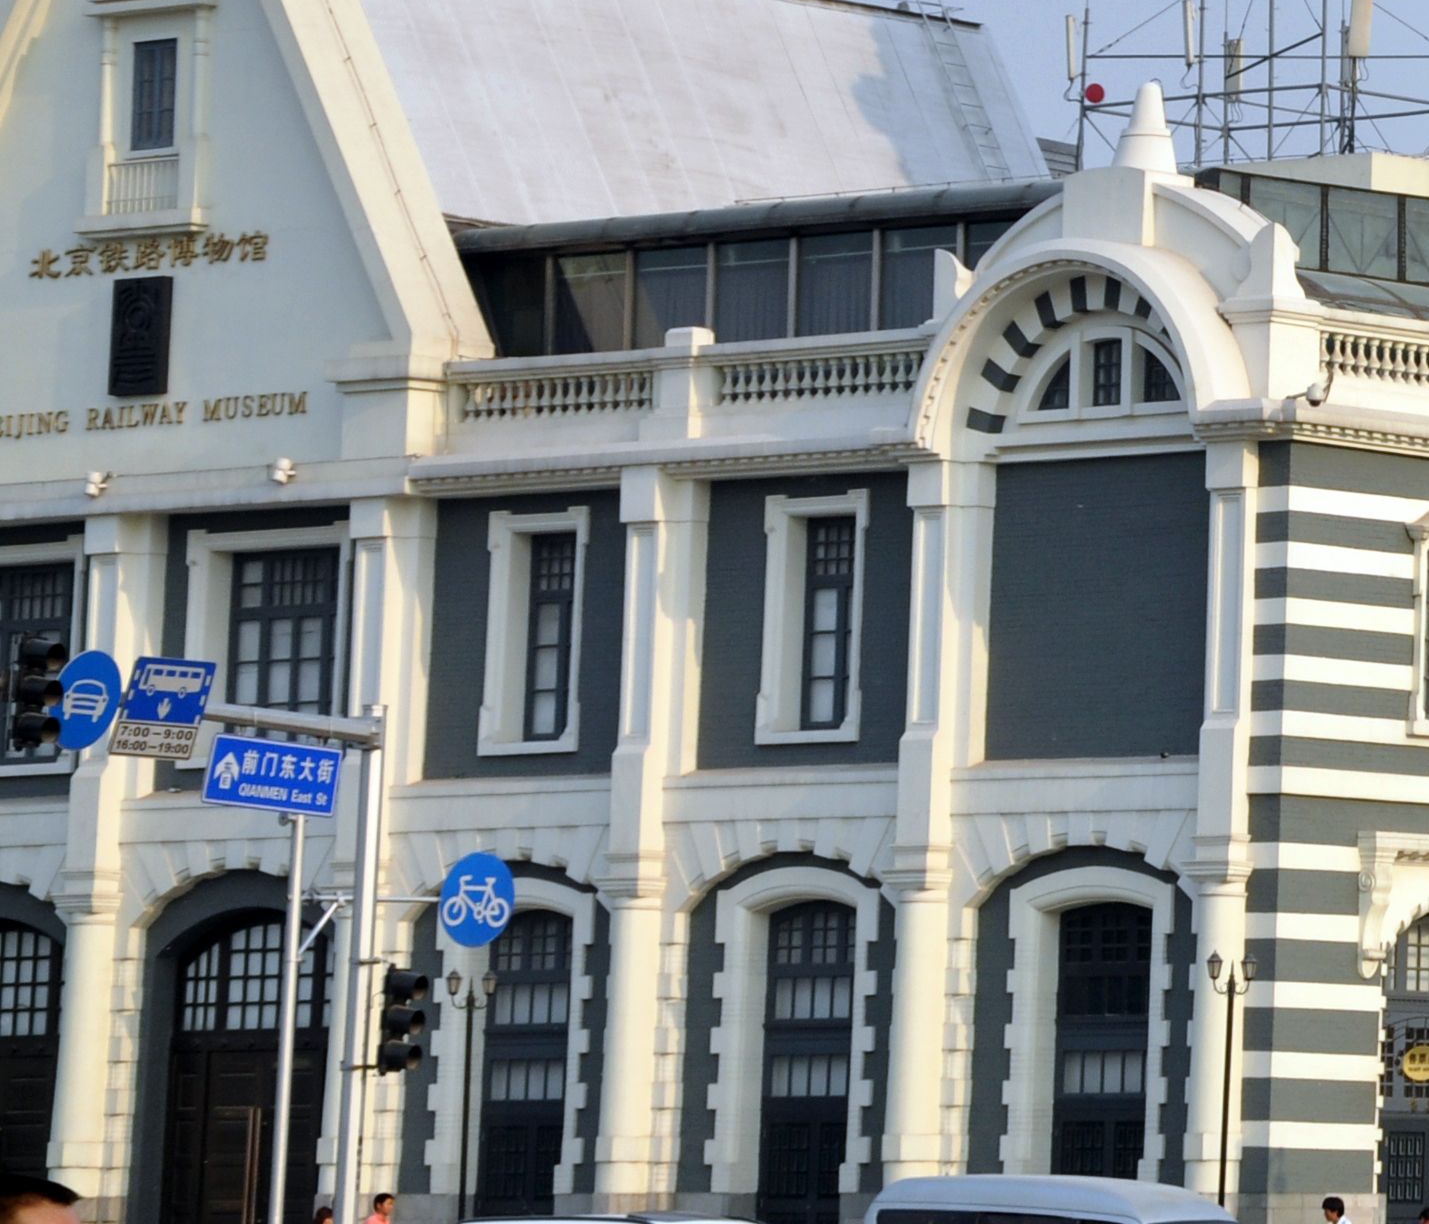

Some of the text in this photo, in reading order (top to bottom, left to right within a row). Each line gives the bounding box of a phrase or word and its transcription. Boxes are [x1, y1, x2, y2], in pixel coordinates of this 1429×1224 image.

[28, 231, 270, 279] 北京铁路博物馆
[85, 401, 187, 431] RAILWAY
[202, 391, 309, 422] MUSEUM
[241, 749, 335, 784] 前门东大街
[238, 783, 328, 806] QIANMEN East St
